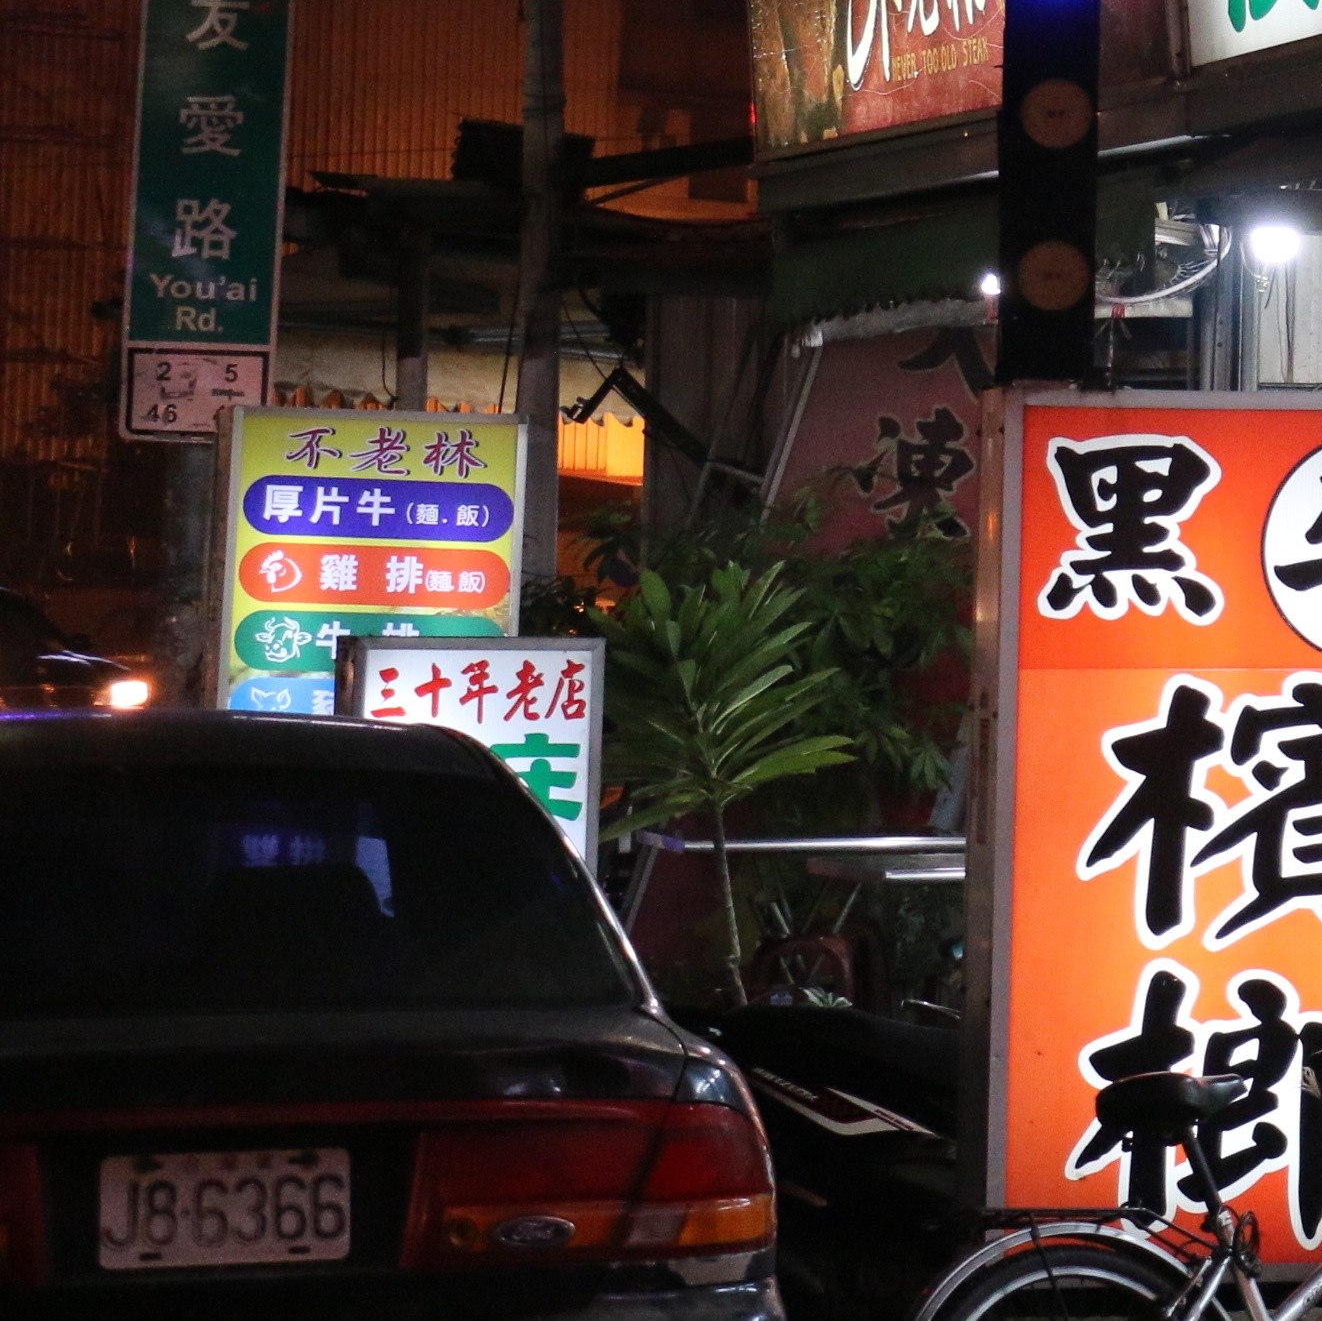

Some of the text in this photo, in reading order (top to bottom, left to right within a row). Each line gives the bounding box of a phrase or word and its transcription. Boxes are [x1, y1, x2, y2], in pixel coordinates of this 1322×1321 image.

[148, 273, 258, 303] You'ai
[174, 307, 224, 333] Rd.
[285, 426, 489, 479] 不老林
[262, 484, 397, 527] 厚片牛
[370, 658, 587, 724] 三十年老店
